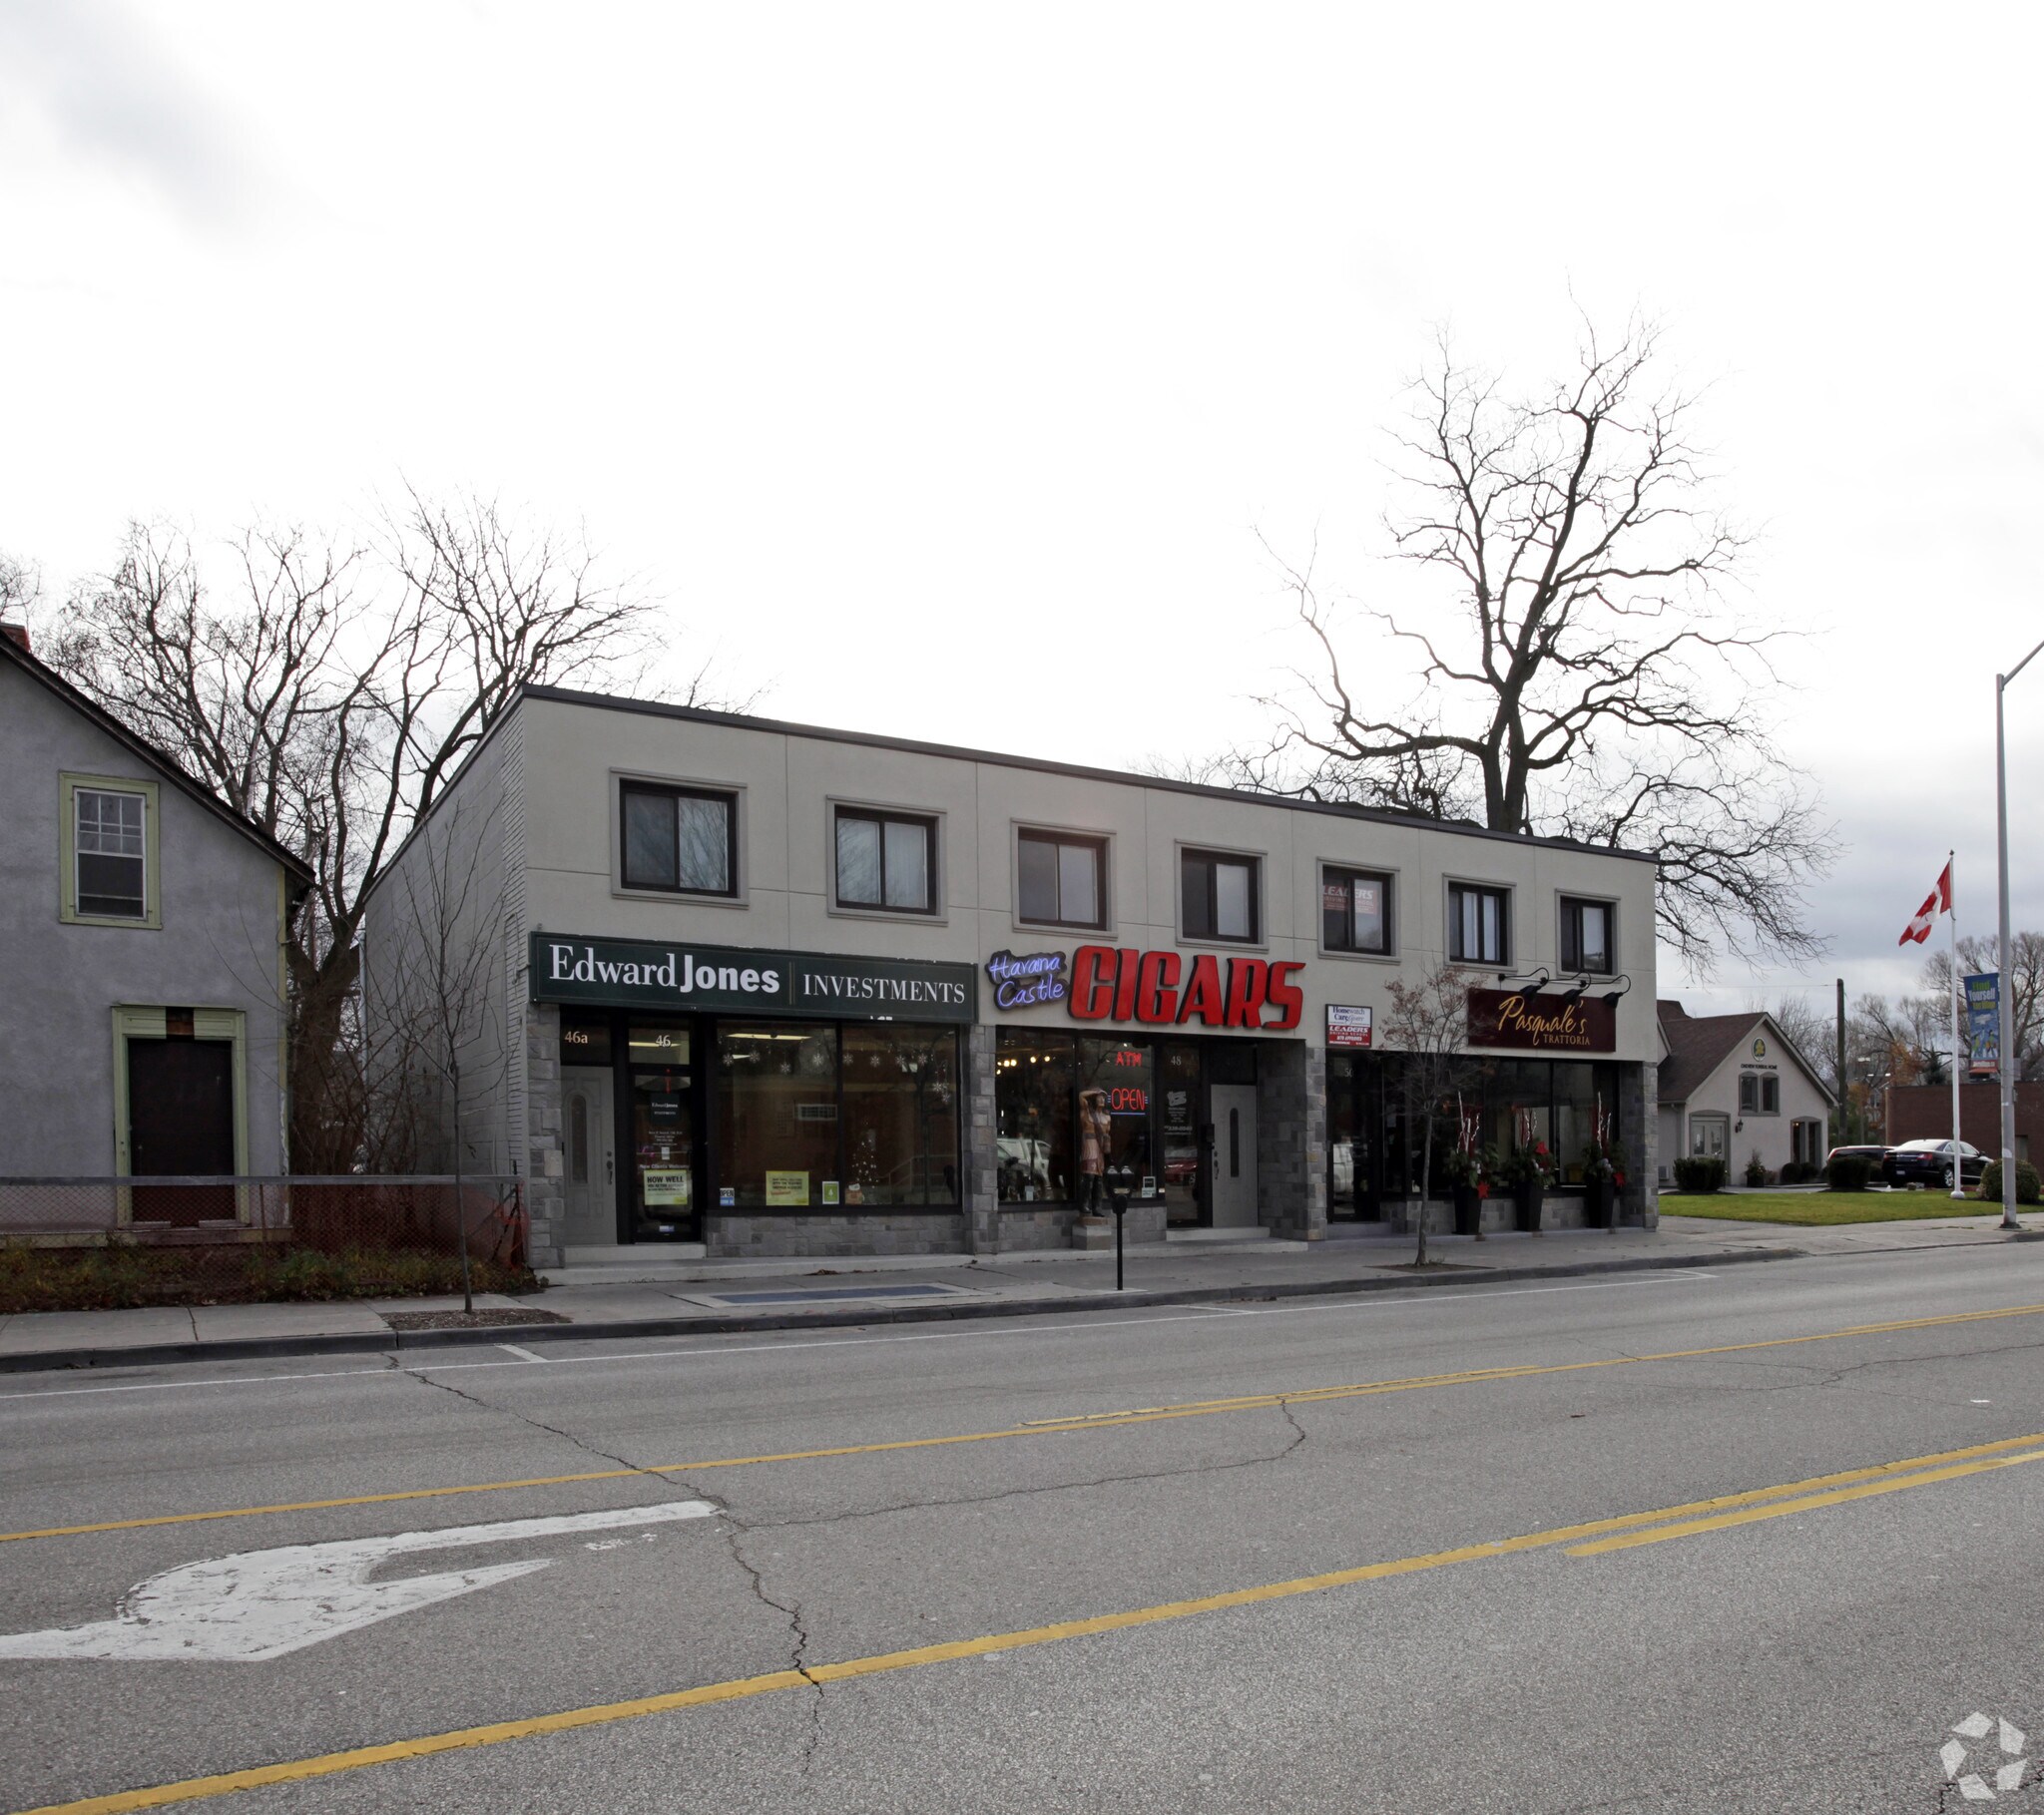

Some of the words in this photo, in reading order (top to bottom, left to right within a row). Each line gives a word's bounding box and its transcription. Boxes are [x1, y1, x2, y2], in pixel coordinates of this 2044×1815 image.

[989, 955, 1061, 982] Havana
[803, 974, 965, 1004] INVESTMENTS
[998, 973, 1065, 1007] Castle
[1068, 945, 1306, 1029] CIGARS
[1967, 987, 1996, 1002] Yourself
[1498, 995, 1587, 1046] Pasquale's
[564, 1031, 588, 1044] 46a
[655, 1035, 672, 1047] 46
[1542, 1034, 1590, 1046] TRATTORIA
[1116, 1051, 1142, 1067] ATM
[1171, 1056, 1182, 1066] 48
[1111, 1088, 1145, 1111] OPEN
